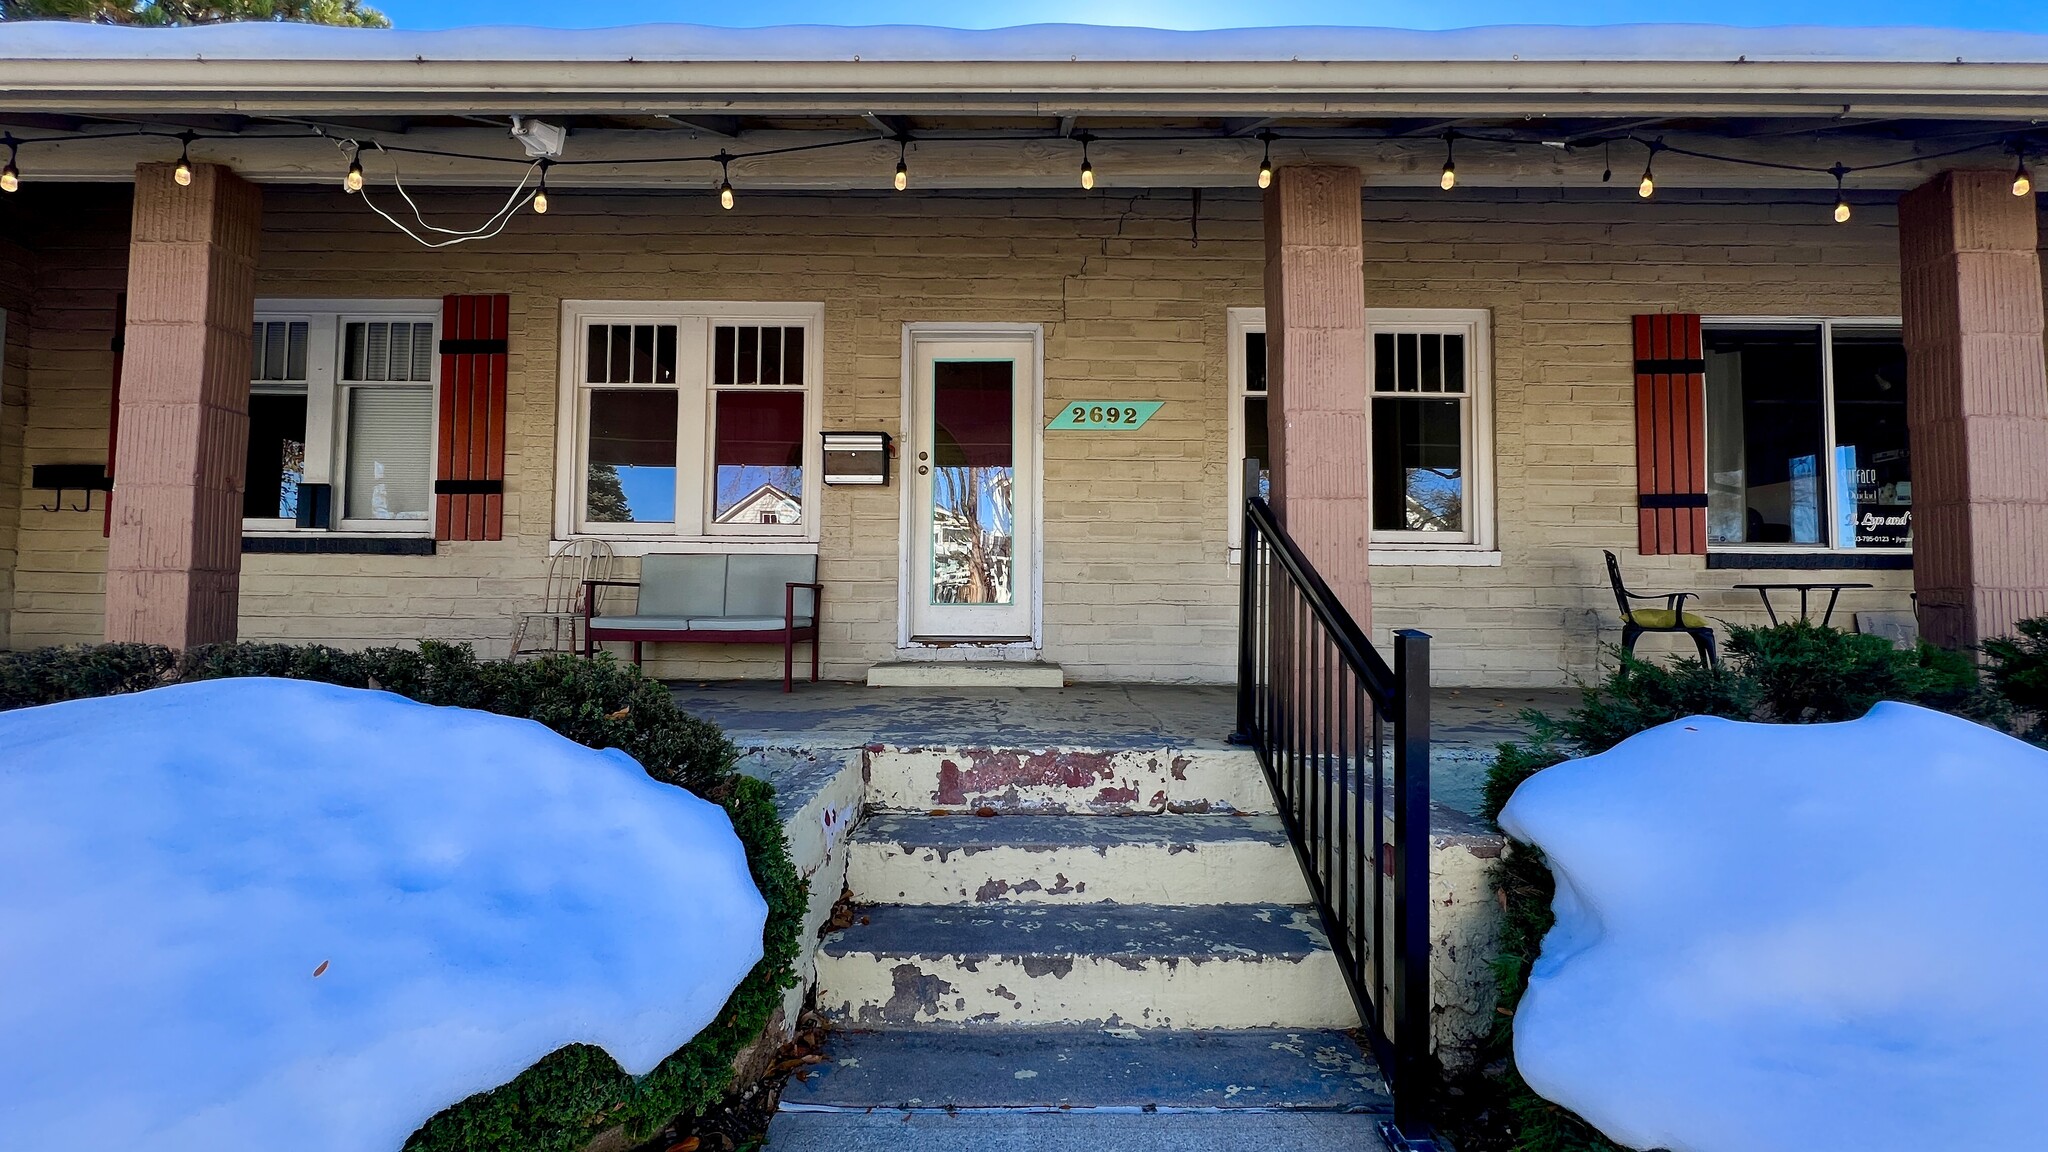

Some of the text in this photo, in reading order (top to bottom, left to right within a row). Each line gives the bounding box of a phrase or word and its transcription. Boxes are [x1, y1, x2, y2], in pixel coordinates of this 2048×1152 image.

[1072, 406, 1137, 424] 2692
[1861, 512, 1885, 532] Lyn
[1885, 511, 1911, 526] and
